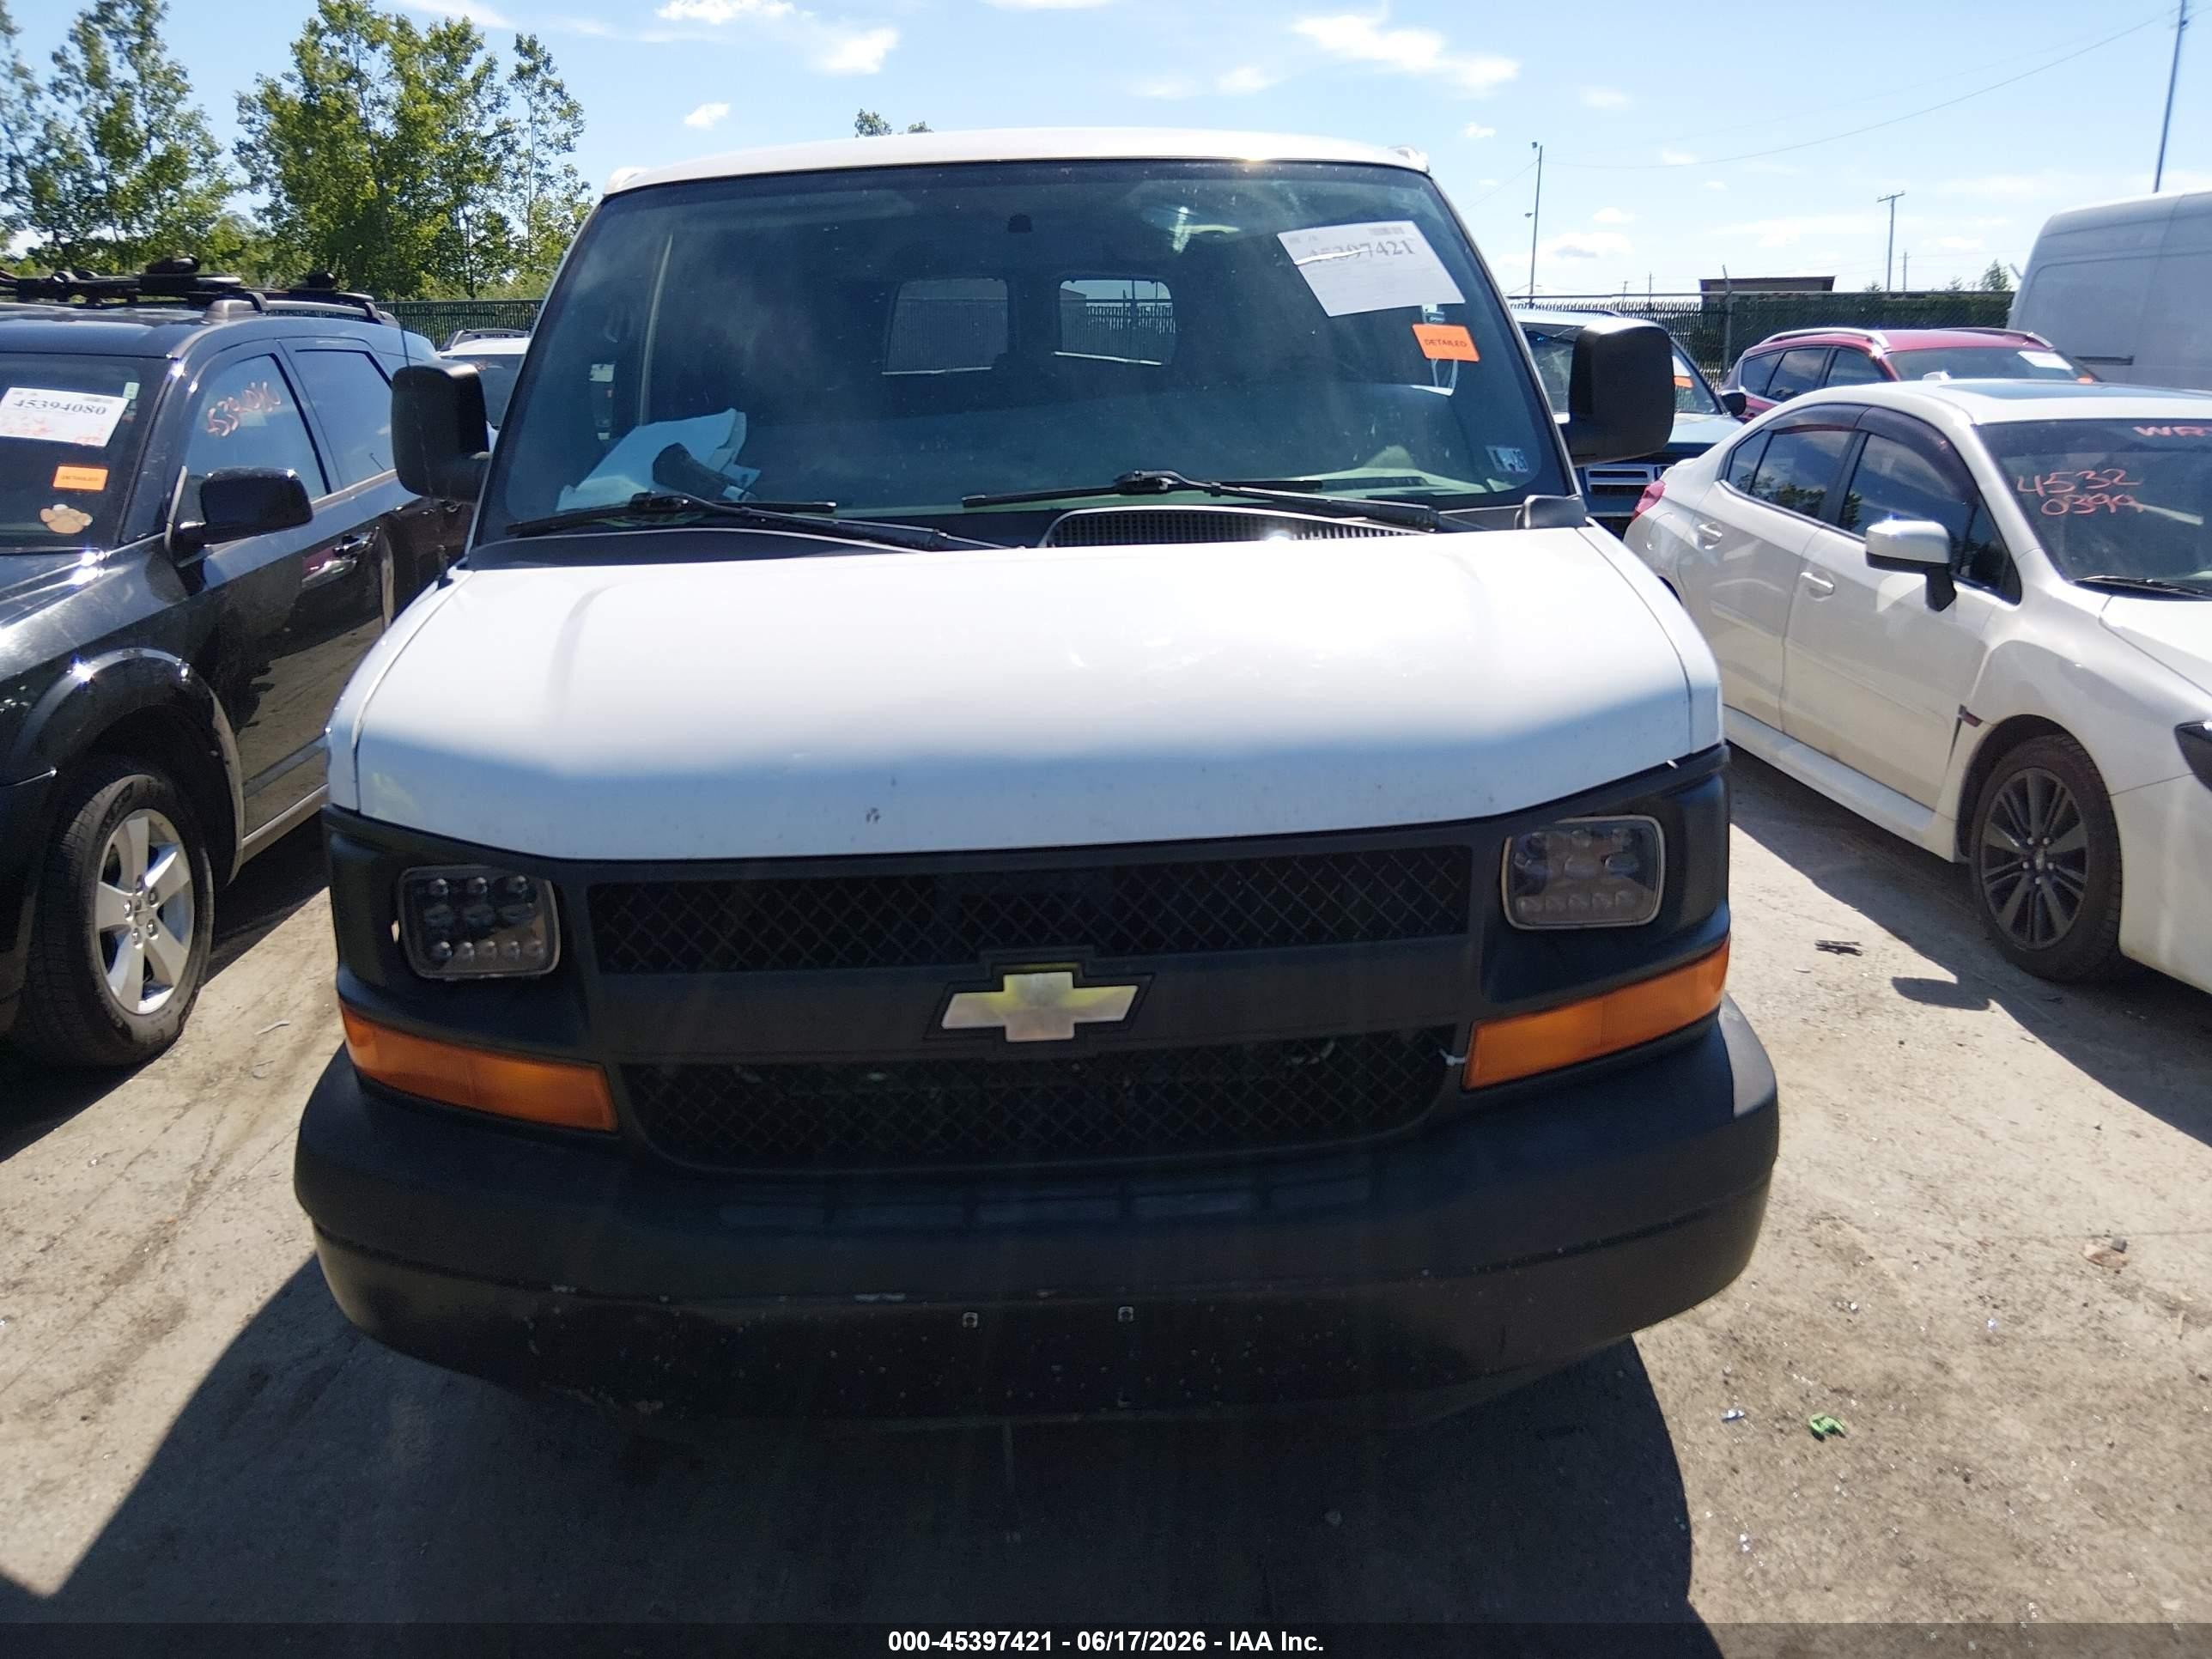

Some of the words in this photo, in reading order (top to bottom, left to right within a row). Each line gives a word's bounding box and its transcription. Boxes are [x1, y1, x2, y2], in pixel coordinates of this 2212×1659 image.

[14, 398, 107, 416] 45394080
[2133, 426, 2212, 436] WR
[2017, 468, 2142, 497] 4532
